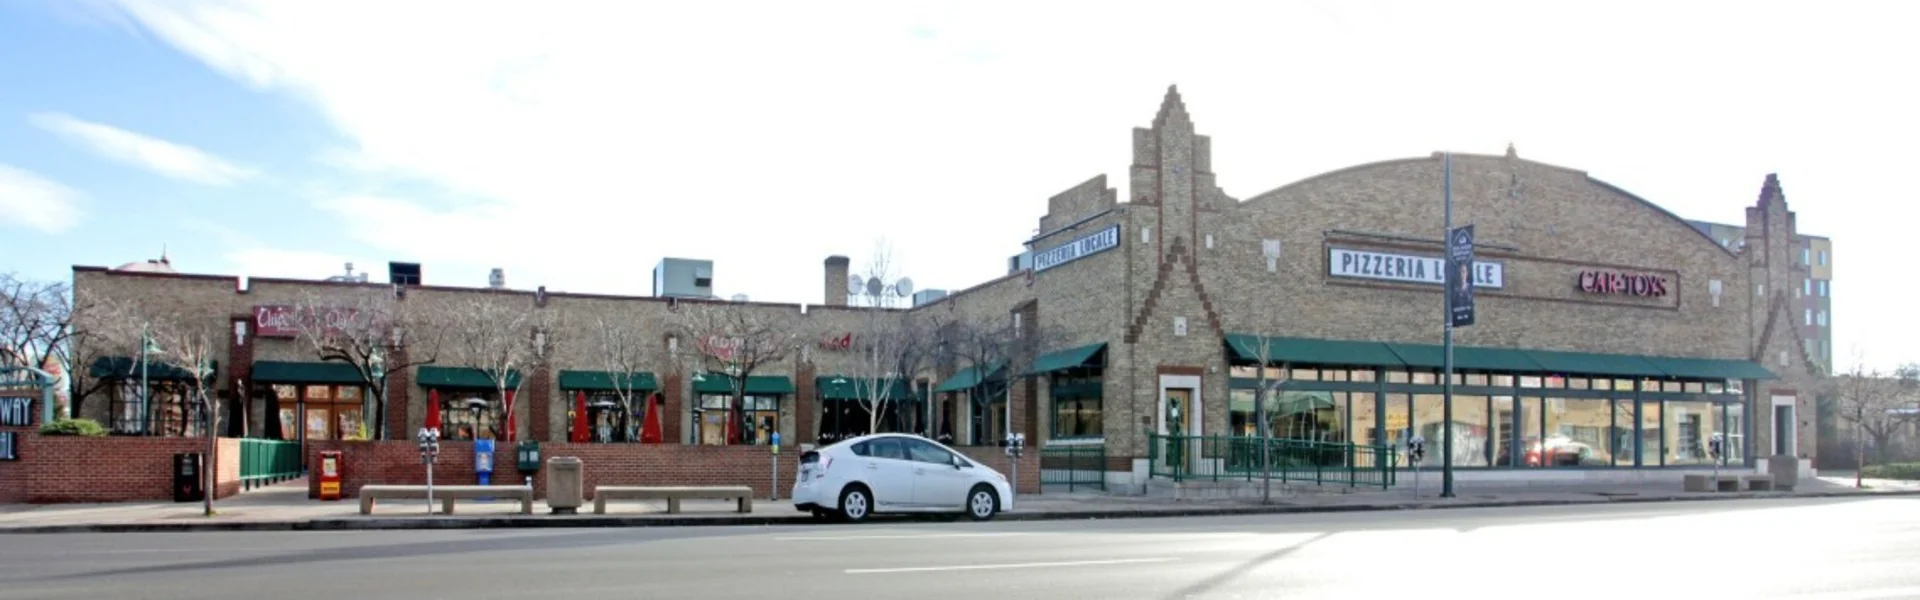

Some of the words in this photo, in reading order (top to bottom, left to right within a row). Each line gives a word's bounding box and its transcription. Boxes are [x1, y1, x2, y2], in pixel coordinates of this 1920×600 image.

[1037, 243, 1077, 269] PIZZERIA
[1080, 230, 1114, 255] LOCALE
[1341, 252, 1426, 280] PIZZERIA
[1434, 260, 1495, 285] LLE
